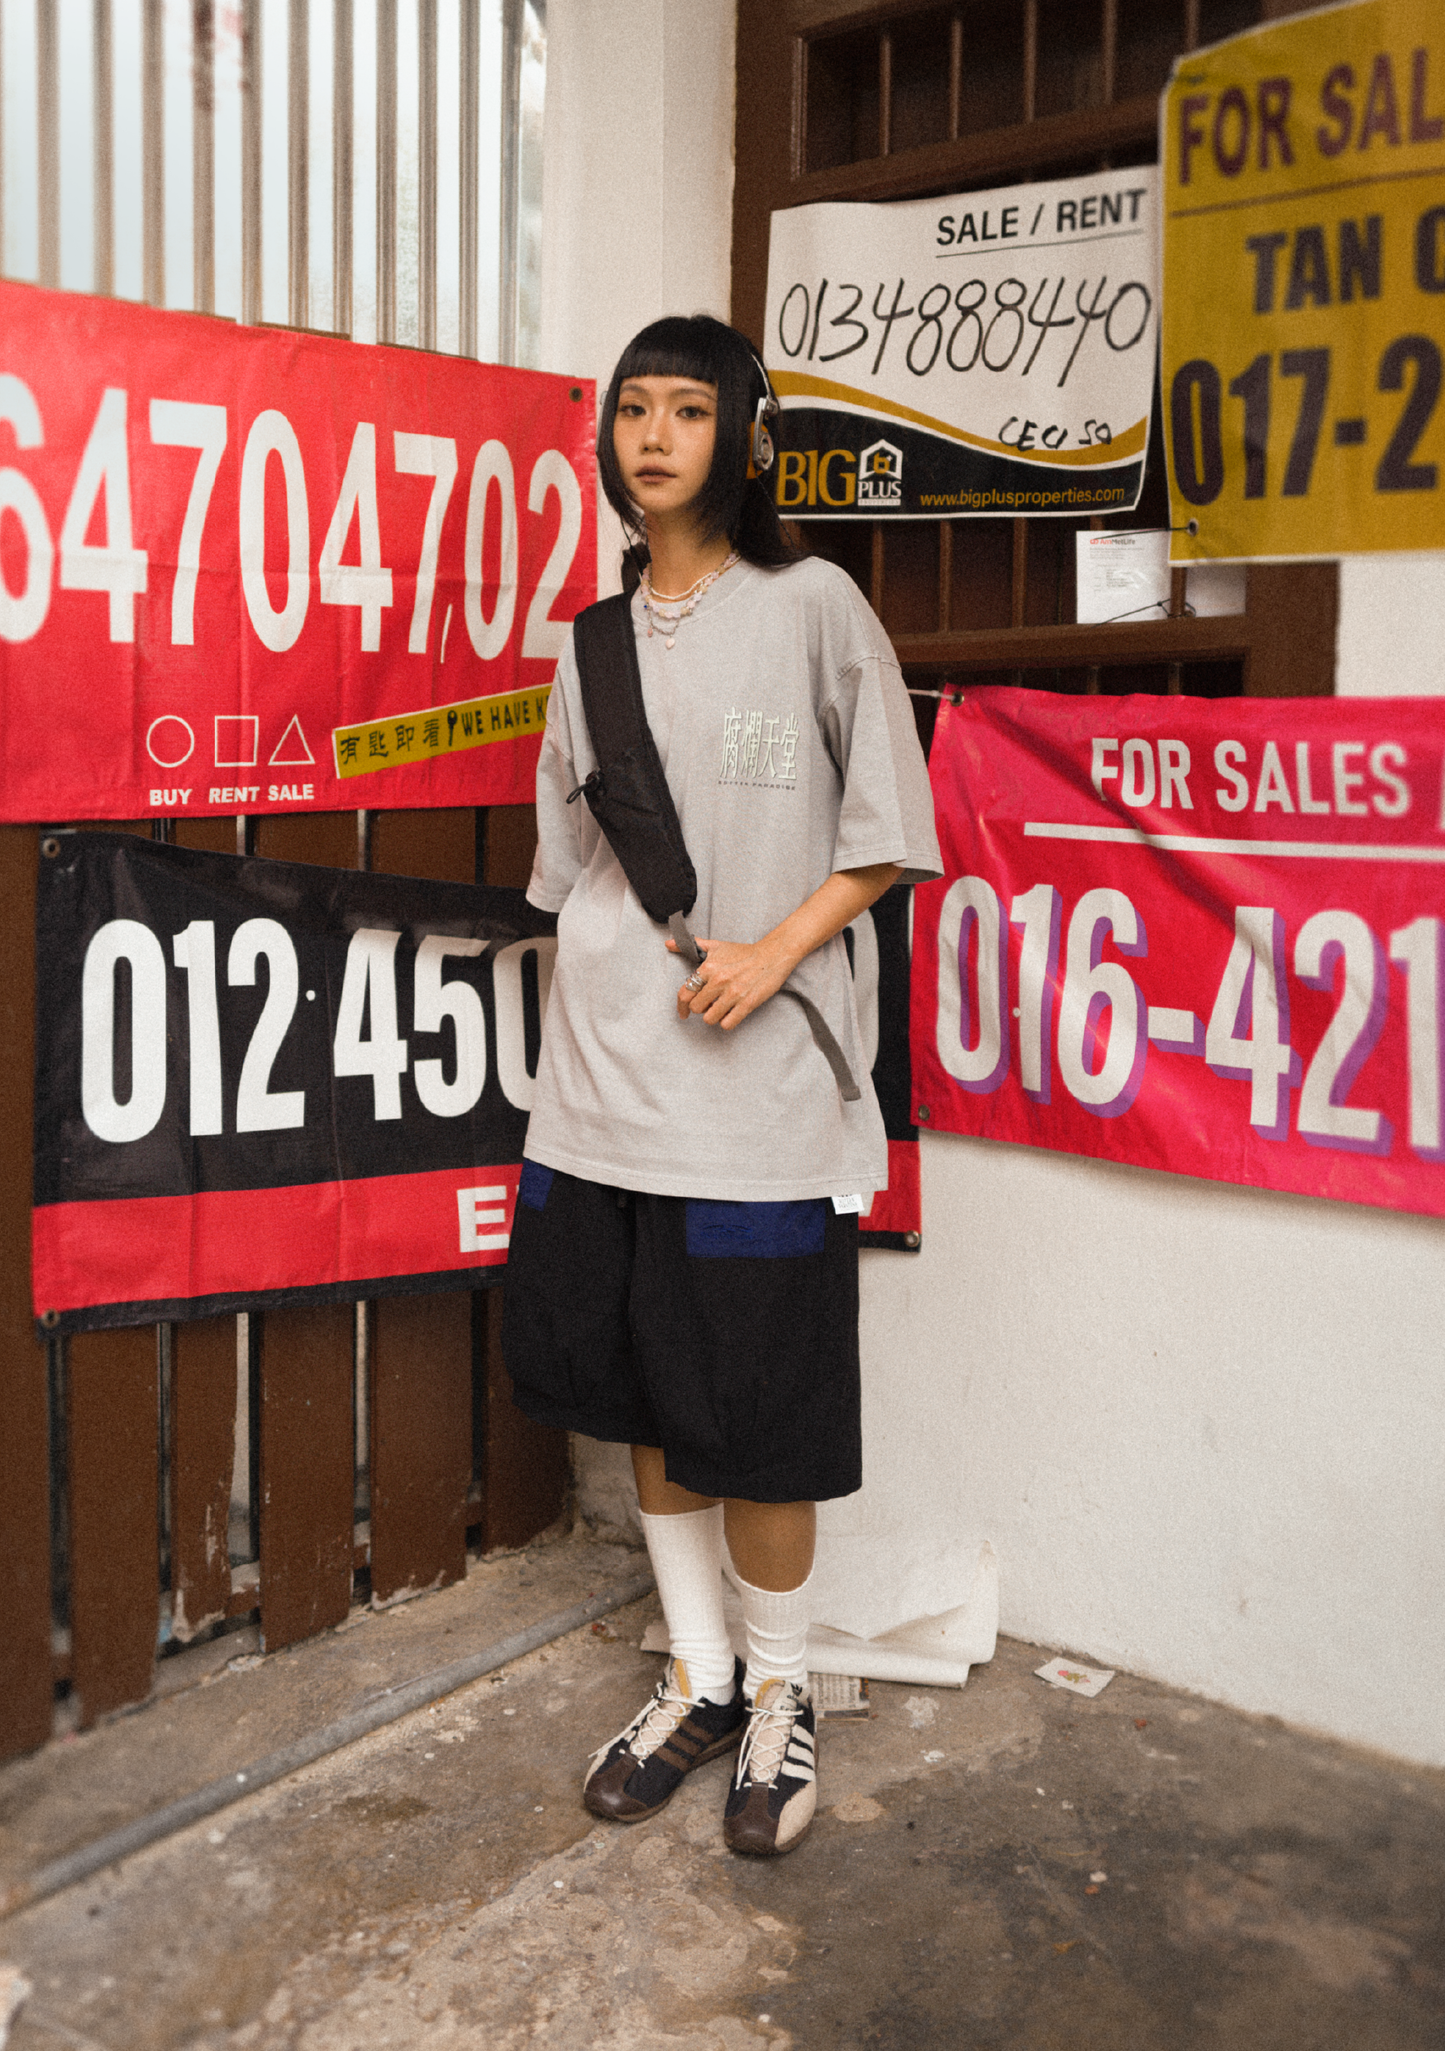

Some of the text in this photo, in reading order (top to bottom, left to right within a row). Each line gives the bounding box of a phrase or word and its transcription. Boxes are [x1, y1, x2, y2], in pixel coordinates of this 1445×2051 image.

[1178, 78, 1295, 187] FOR
[936, 207, 1019, 246] SALE
[1057, 188, 1147, 233] RENT
[1246, 213, 1384, 316] TAN
[1170, 333, 1442, 506] 017-2
[776, 449, 857, 507] BIG
[858, 481, 902, 498] PLUS
[920, 486, 1125, 508] www.bigplusproperties.com
[461, 710, 484, 737] WE
[490, 701, 531, 731] HAVE
[150, 784, 315, 806] BUY RENT SALE
[1091, 737, 1194, 809] FOR
[1214, 740, 1409, 817] SALES
